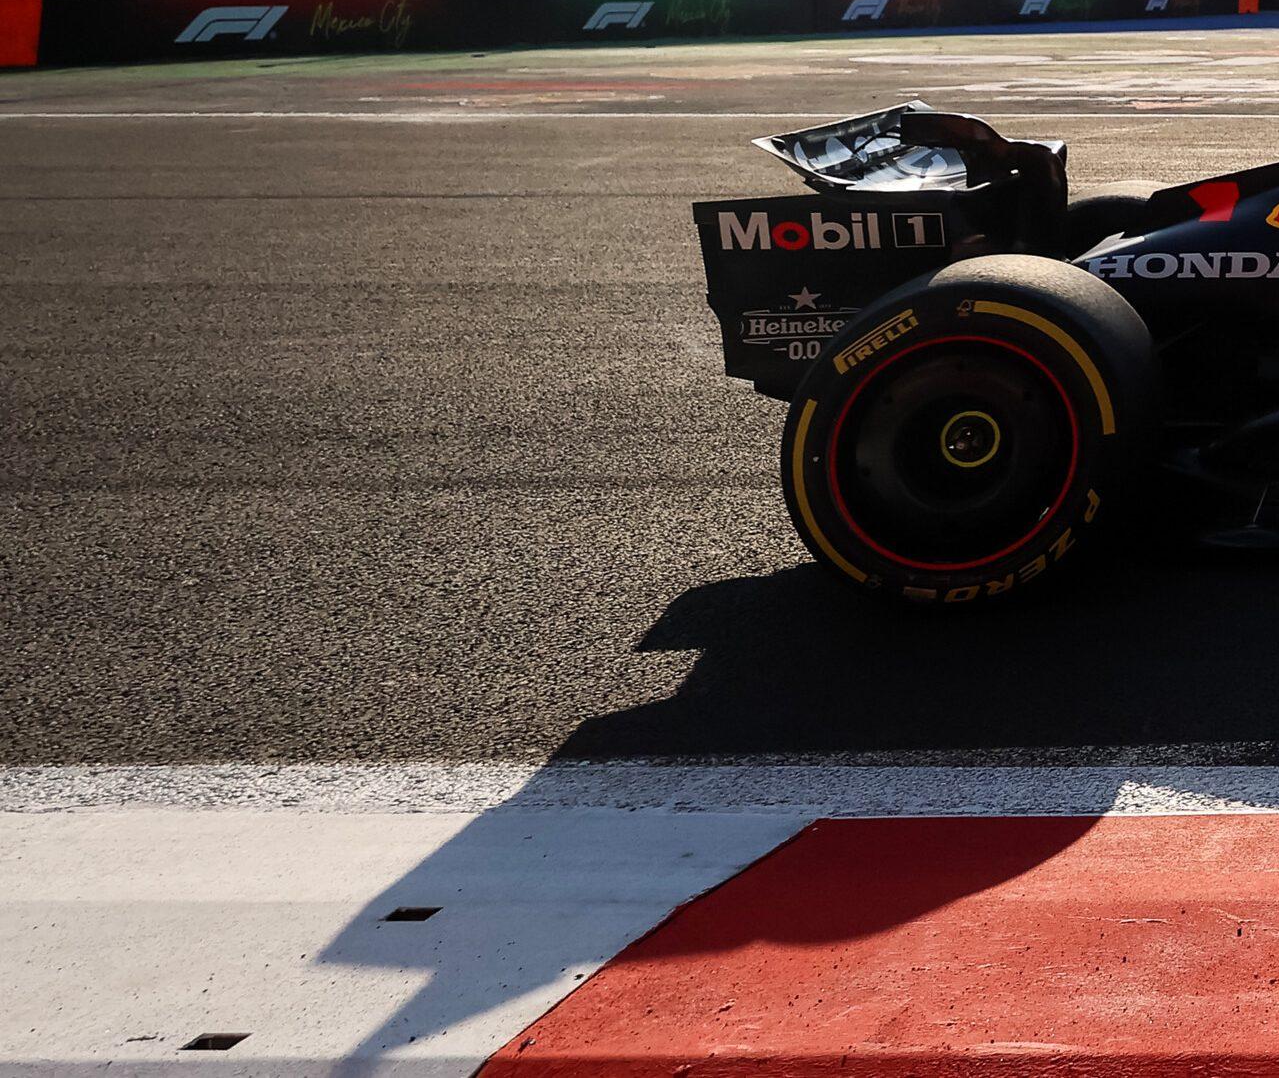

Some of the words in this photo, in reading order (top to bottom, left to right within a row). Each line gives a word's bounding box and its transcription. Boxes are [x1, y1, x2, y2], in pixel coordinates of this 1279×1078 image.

[174, 6, 289, 44] F1
[310, 4, 370, 36] Mexico
[582, 1, 655, 30] F1
[717, 211, 881, 251] Mobil
[749, 316, 846, 336] Heineke
[832, 308, 919, 375] PIRELLI
[944, 526, 1077, 603] ZERO
